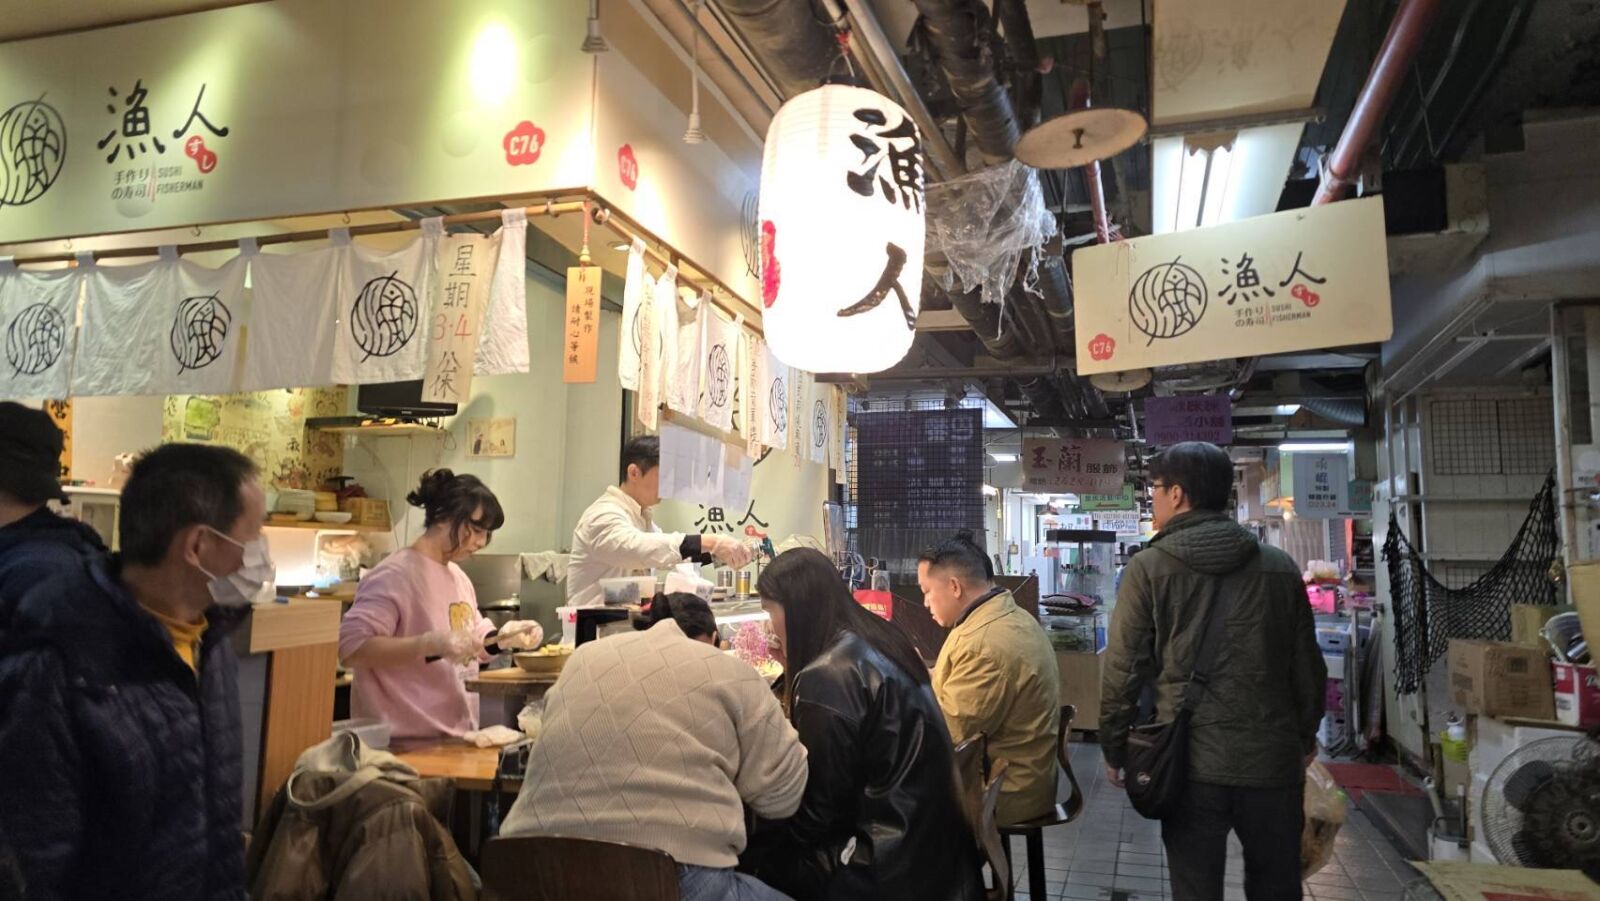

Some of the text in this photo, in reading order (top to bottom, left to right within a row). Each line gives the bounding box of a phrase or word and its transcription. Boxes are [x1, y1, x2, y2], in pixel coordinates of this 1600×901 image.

[97, 78, 229, 164] 漁人
[509, 133, 540, 156] C76
[158, 166, 183, 178] SUSHI
[157, 180, 204, 194] FISHERMAN
[1218, 251, 1327, 306] 漁人
[1271, 303, 1292, 313] SUSHI
[1272, 311, 1311, 323] FISHERMAN
[1093, 341, 1112, 355] C76
